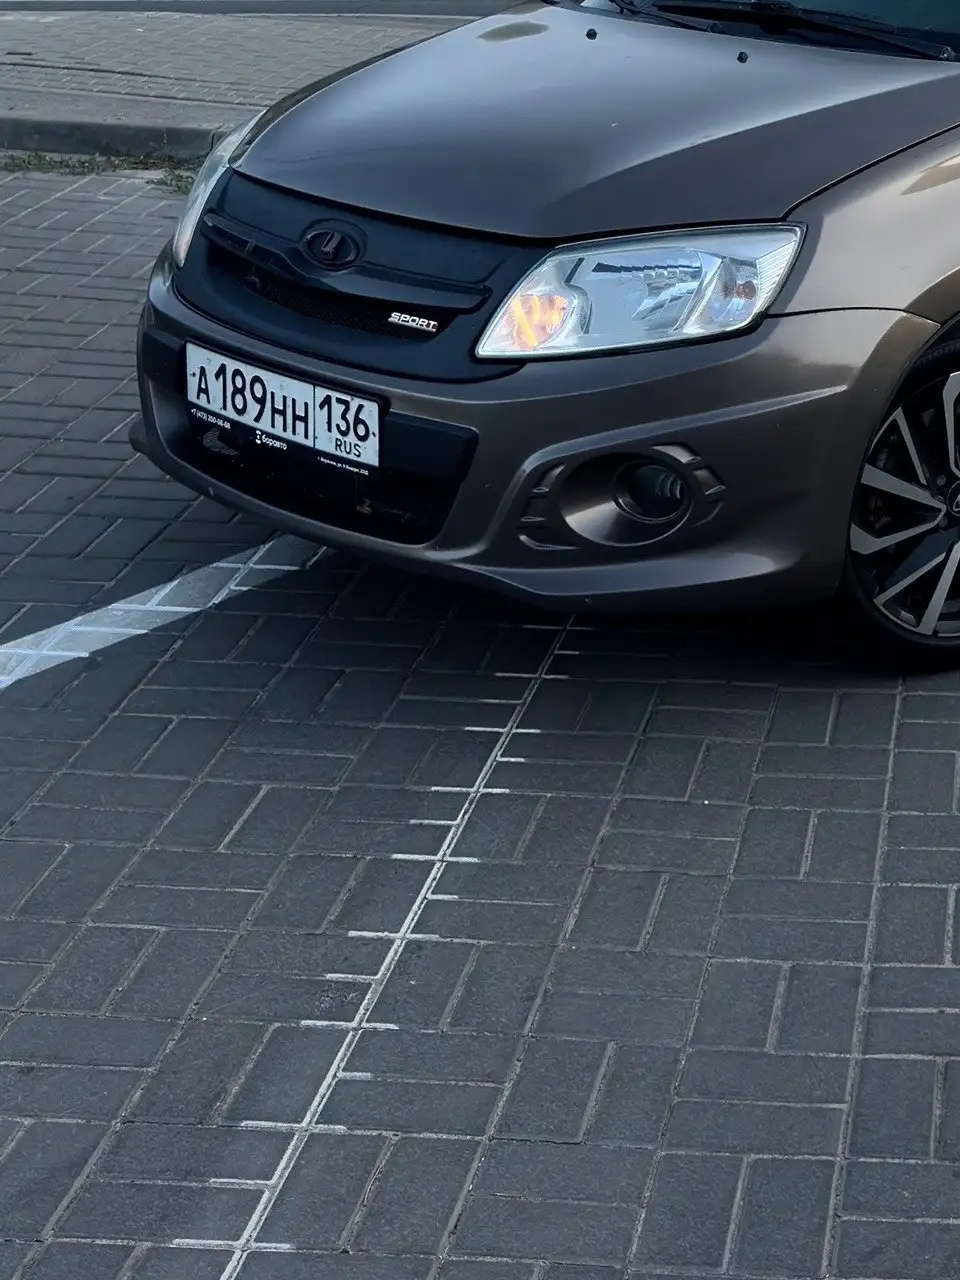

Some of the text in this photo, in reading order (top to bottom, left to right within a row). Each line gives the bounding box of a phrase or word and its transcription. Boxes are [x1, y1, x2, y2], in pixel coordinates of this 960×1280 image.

[388, 312, 438, 332] SPORT
[196, 363, 370, 442] А189НН 136
[334, 437, 362, 458] RUS
